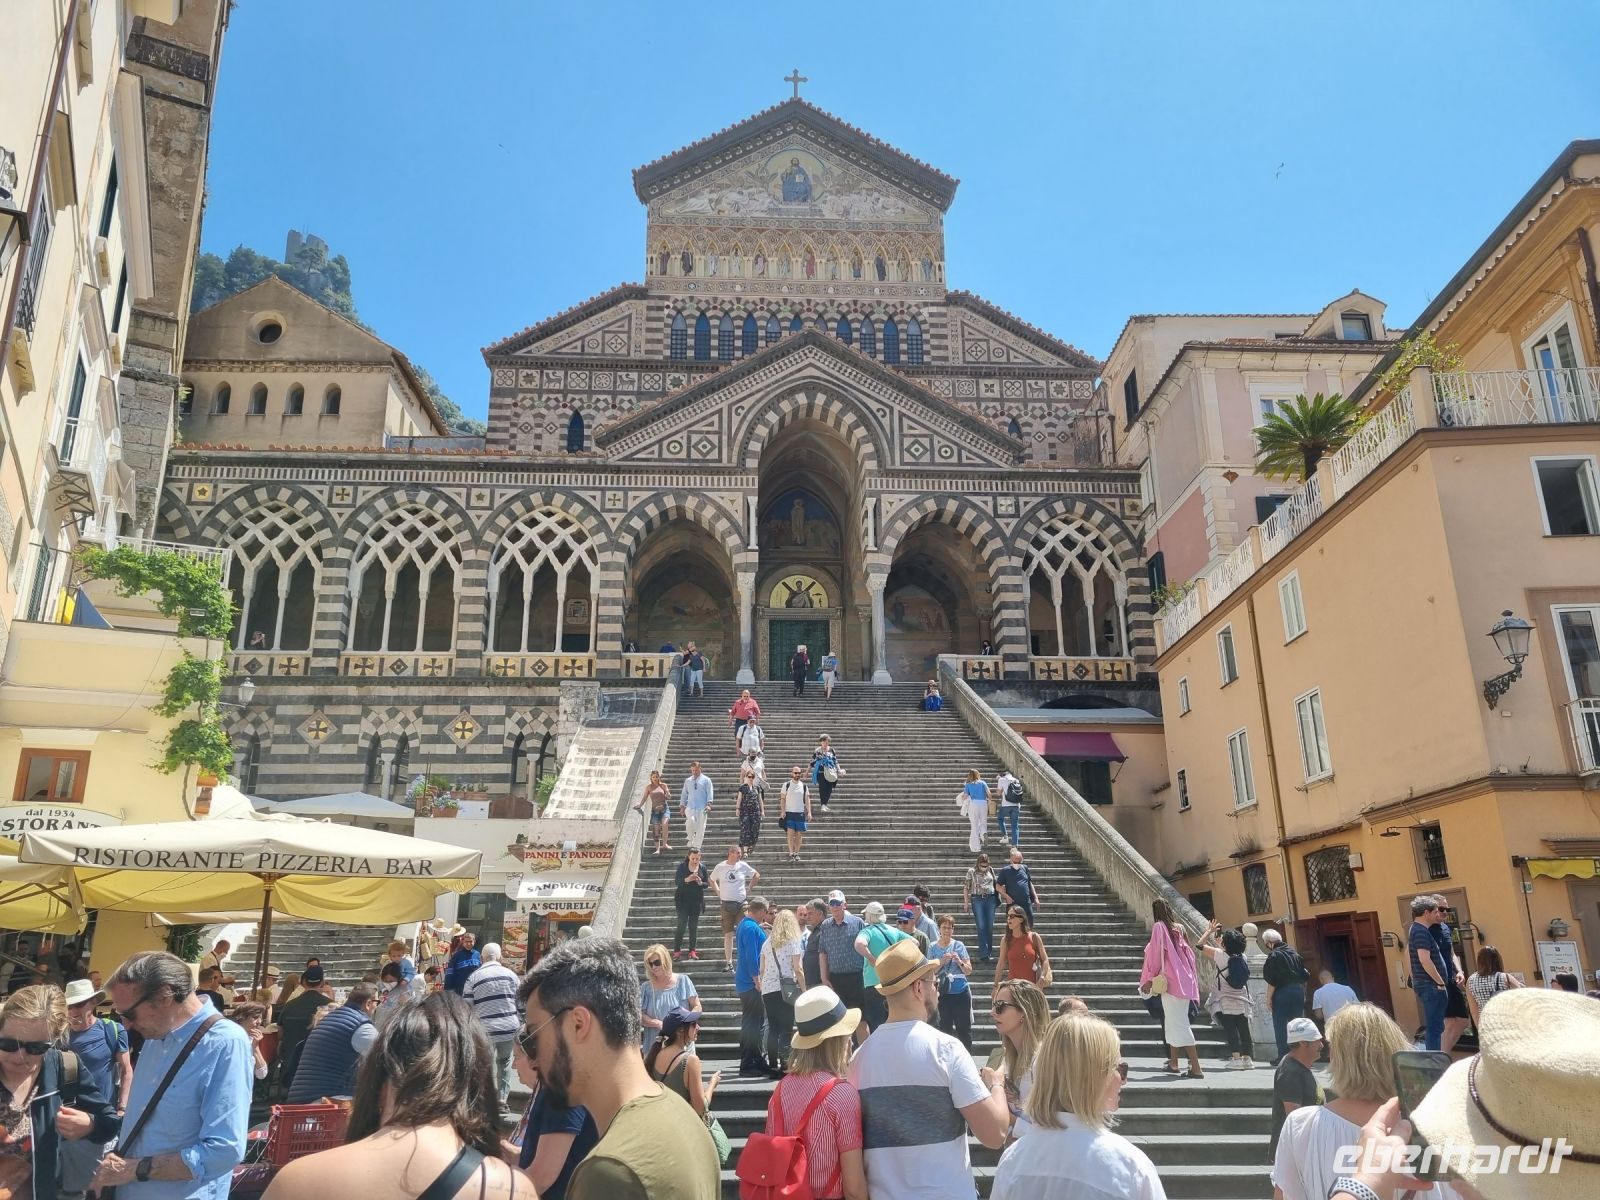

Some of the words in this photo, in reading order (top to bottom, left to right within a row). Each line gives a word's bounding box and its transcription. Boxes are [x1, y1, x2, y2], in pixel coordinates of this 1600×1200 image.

[25, 808, 43, 816] dal
[48, 809, 76, 818] 1934
[525, 851, 559, 859] PANINI
[560, 851, 568, 859] E
[72, 847, 245, 869] RISTORANTE
[256, 852, 373, 875] PIZZERIA
[384, 857, 433, 876] BAR
[527, 881, 604, 893] SANDWICHES
